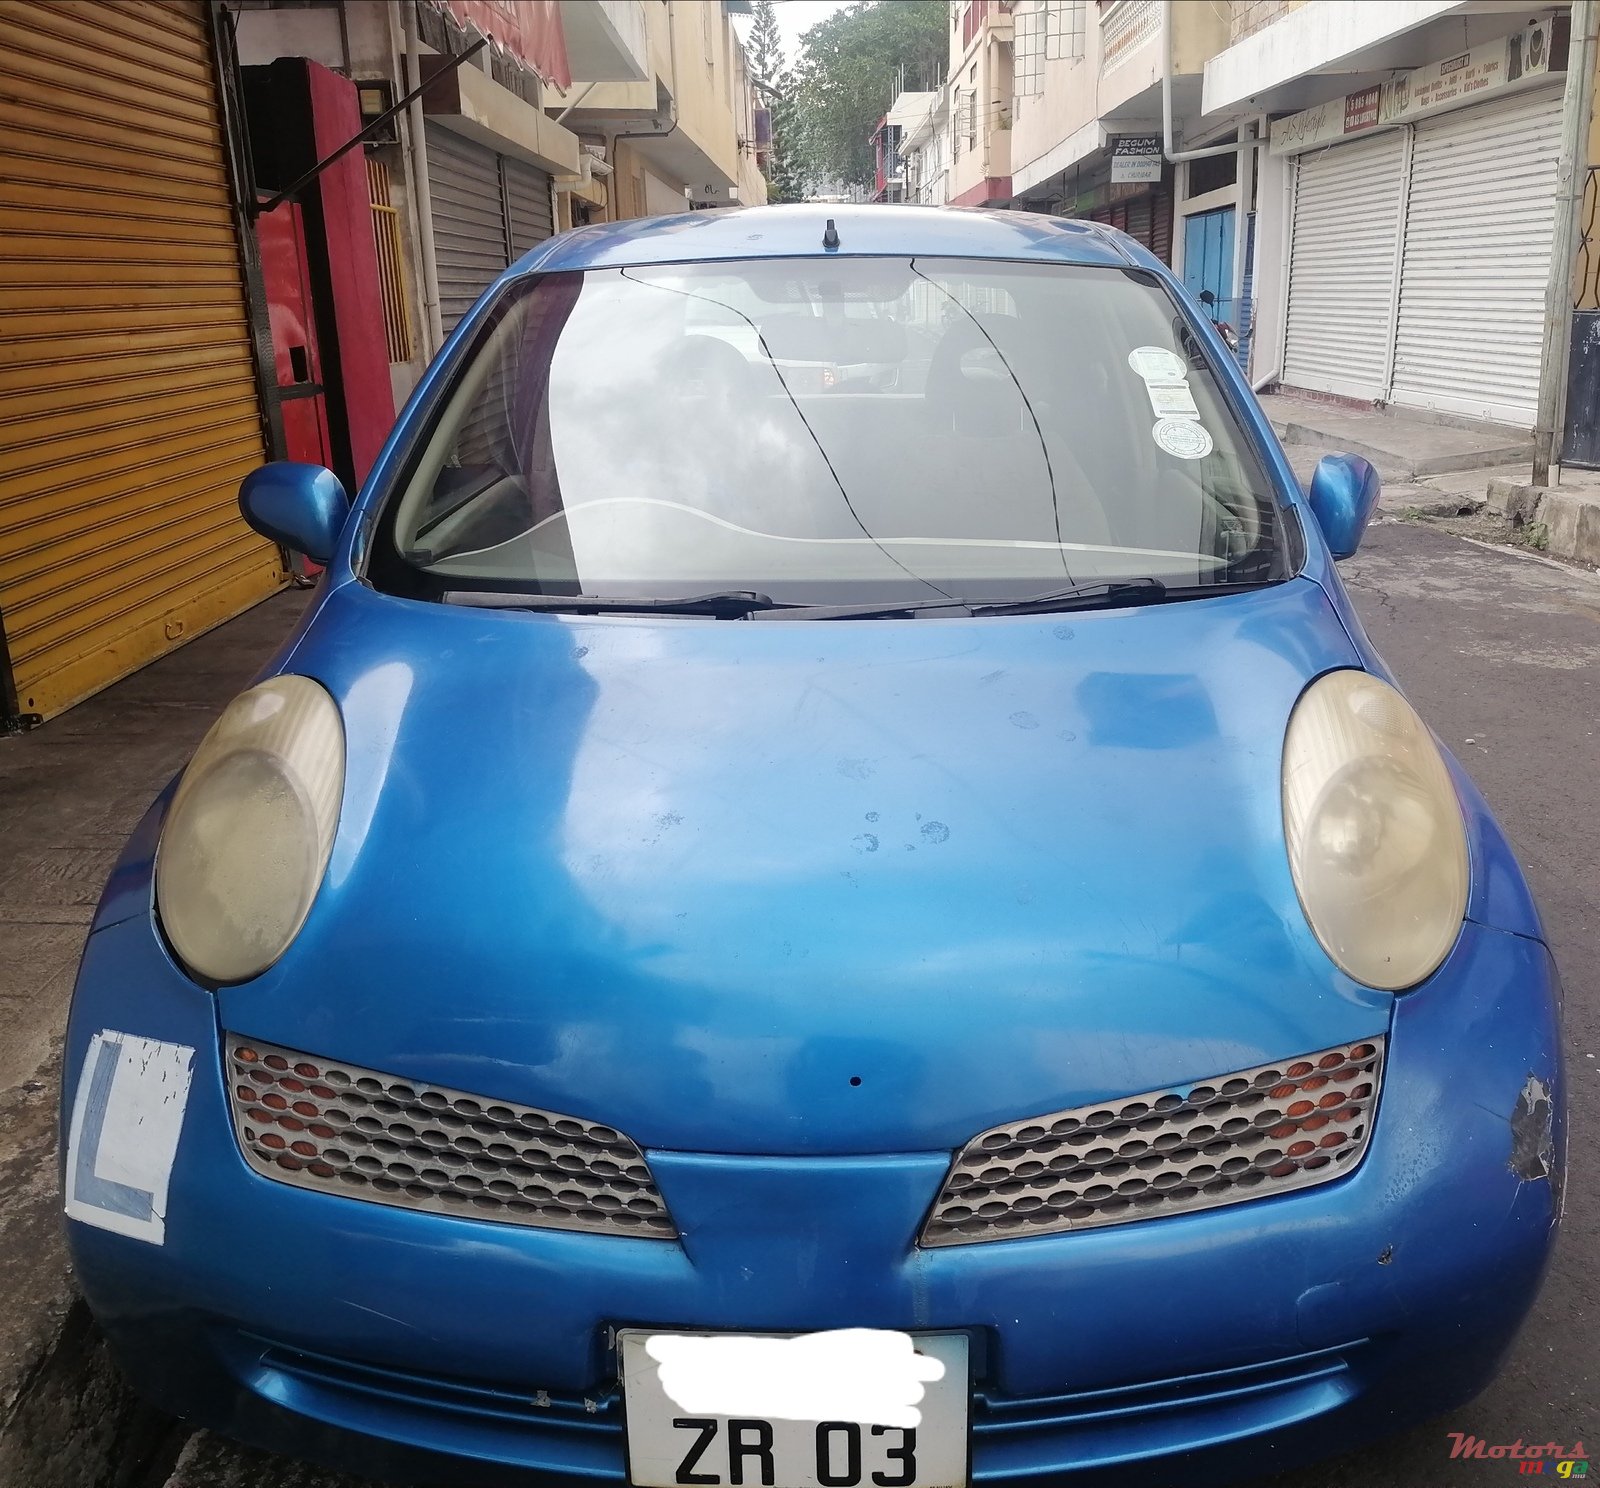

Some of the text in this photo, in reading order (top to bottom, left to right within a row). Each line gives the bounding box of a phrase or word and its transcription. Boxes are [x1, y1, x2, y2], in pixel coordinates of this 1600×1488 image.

[1118, 138, 1156, 148] BEGUM
[1115, 147, 1160, 155] FASHION
[672, 1417, 918, 1488] ZR 03
